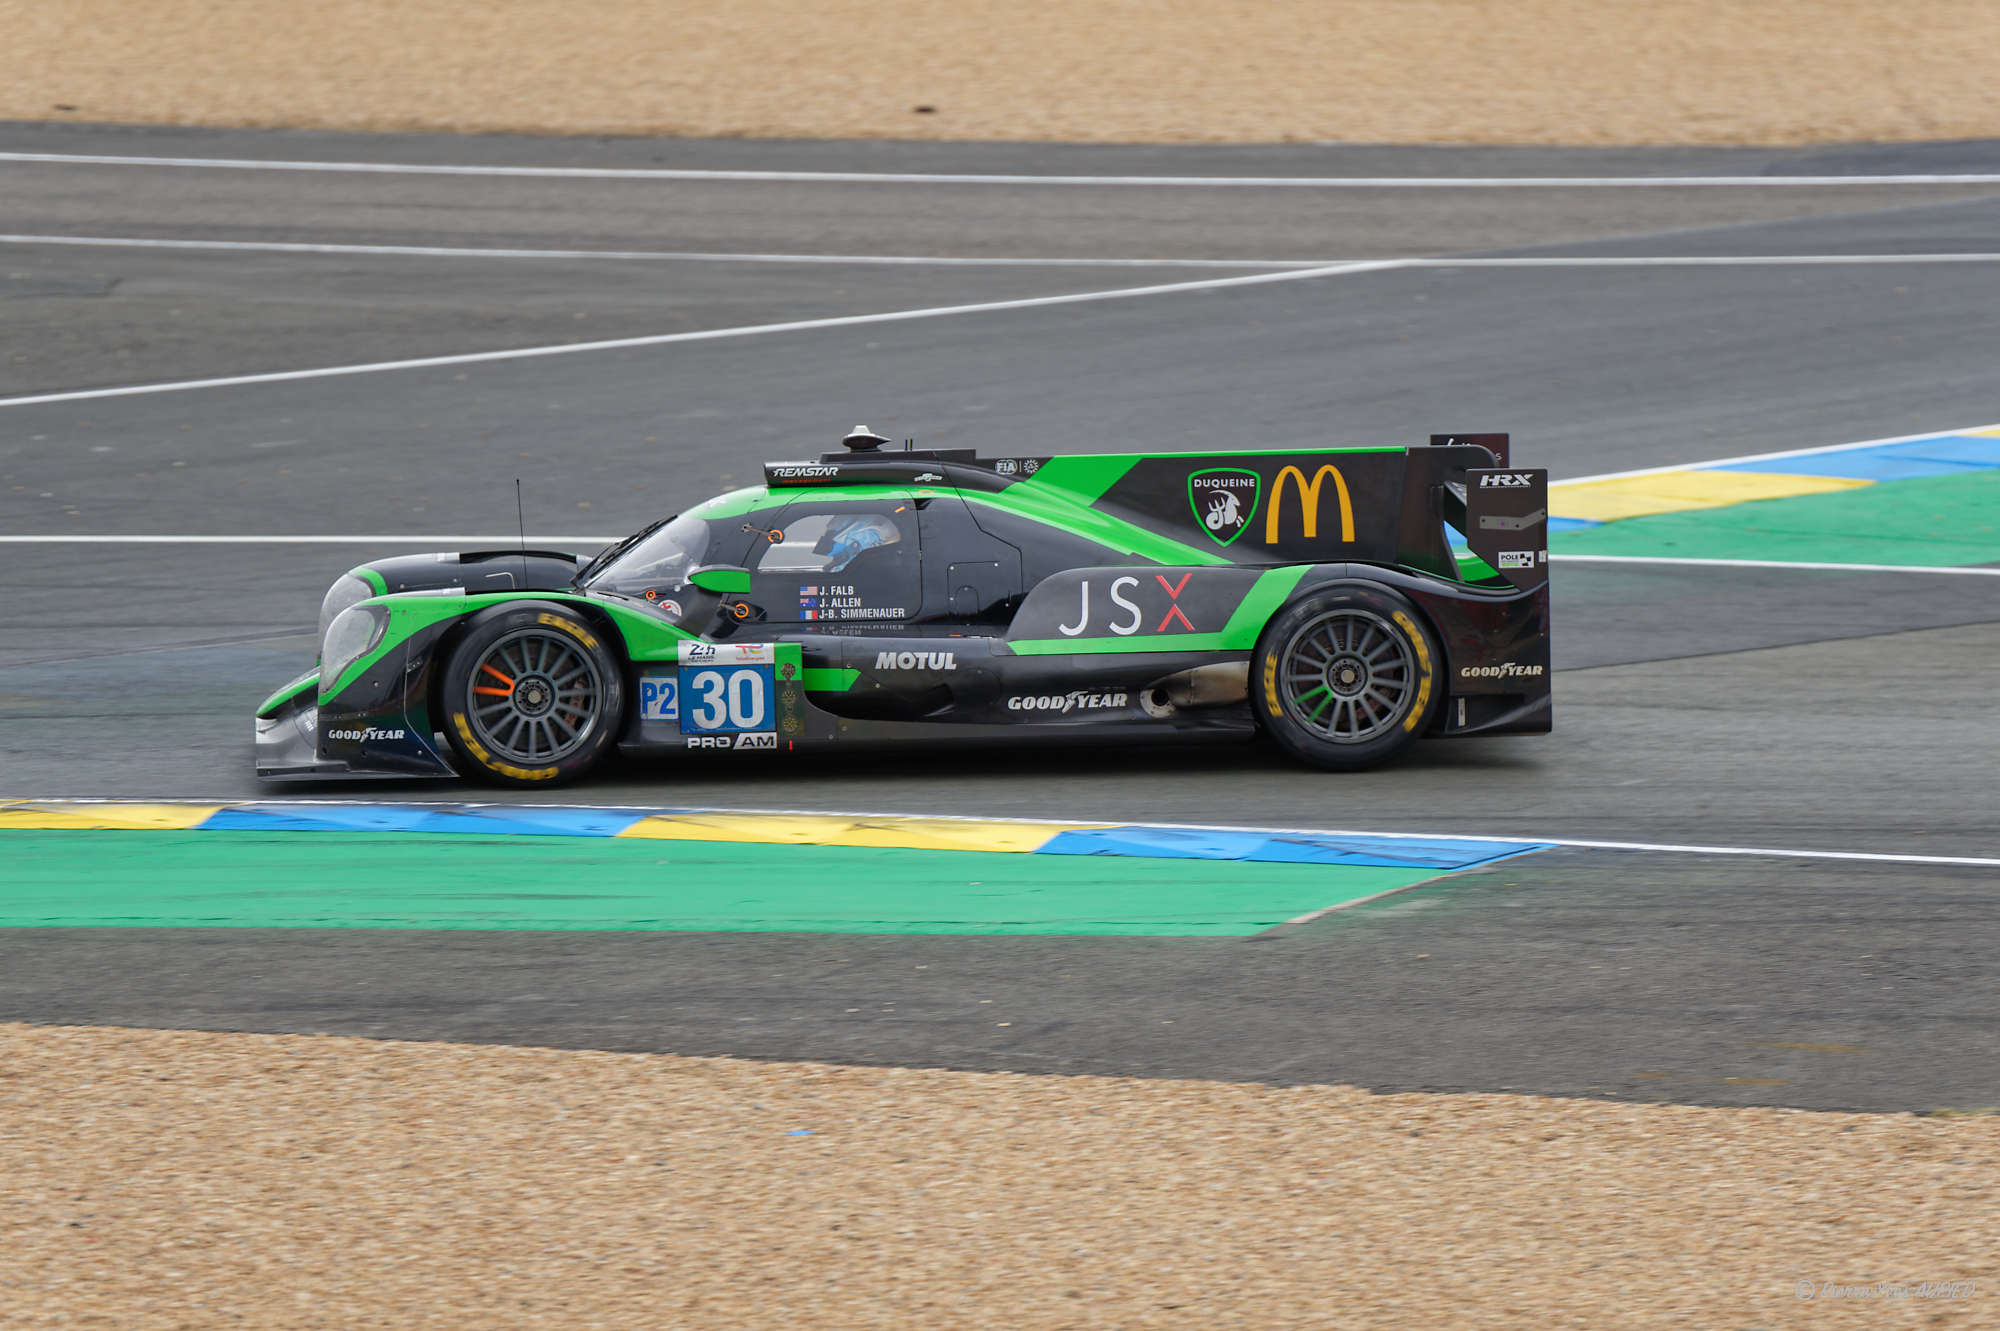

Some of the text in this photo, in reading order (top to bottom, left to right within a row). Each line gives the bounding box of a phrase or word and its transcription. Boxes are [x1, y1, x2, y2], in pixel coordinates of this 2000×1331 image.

[773, 467, 839, 477] REMSTAR
[996, 461, 1016, 473] FIA
[1193, 478, 1256, 488] DUQUEINE
[1480, 474, 1534, 487] HRX
[819, 585, 855, 596] J. FALB
[819, 598, 861, 608] J. ALLEN
[1058, 572, 1196, 636] JSX
[818, 608, 905, 619] J-B. SIMMENAUER
[875, 651, 957, 670] MOTUL
[1460, 662, 1543, 678] GOODYEAR
[641, 682, 676, 714] P2
[692, 669, 765, 729] 30
[1007, 690, 1128, 713] GOODYEAR
[328, 727, 405, 742] GOODYEAR
[687, 735, 775, 748] PRO AM
